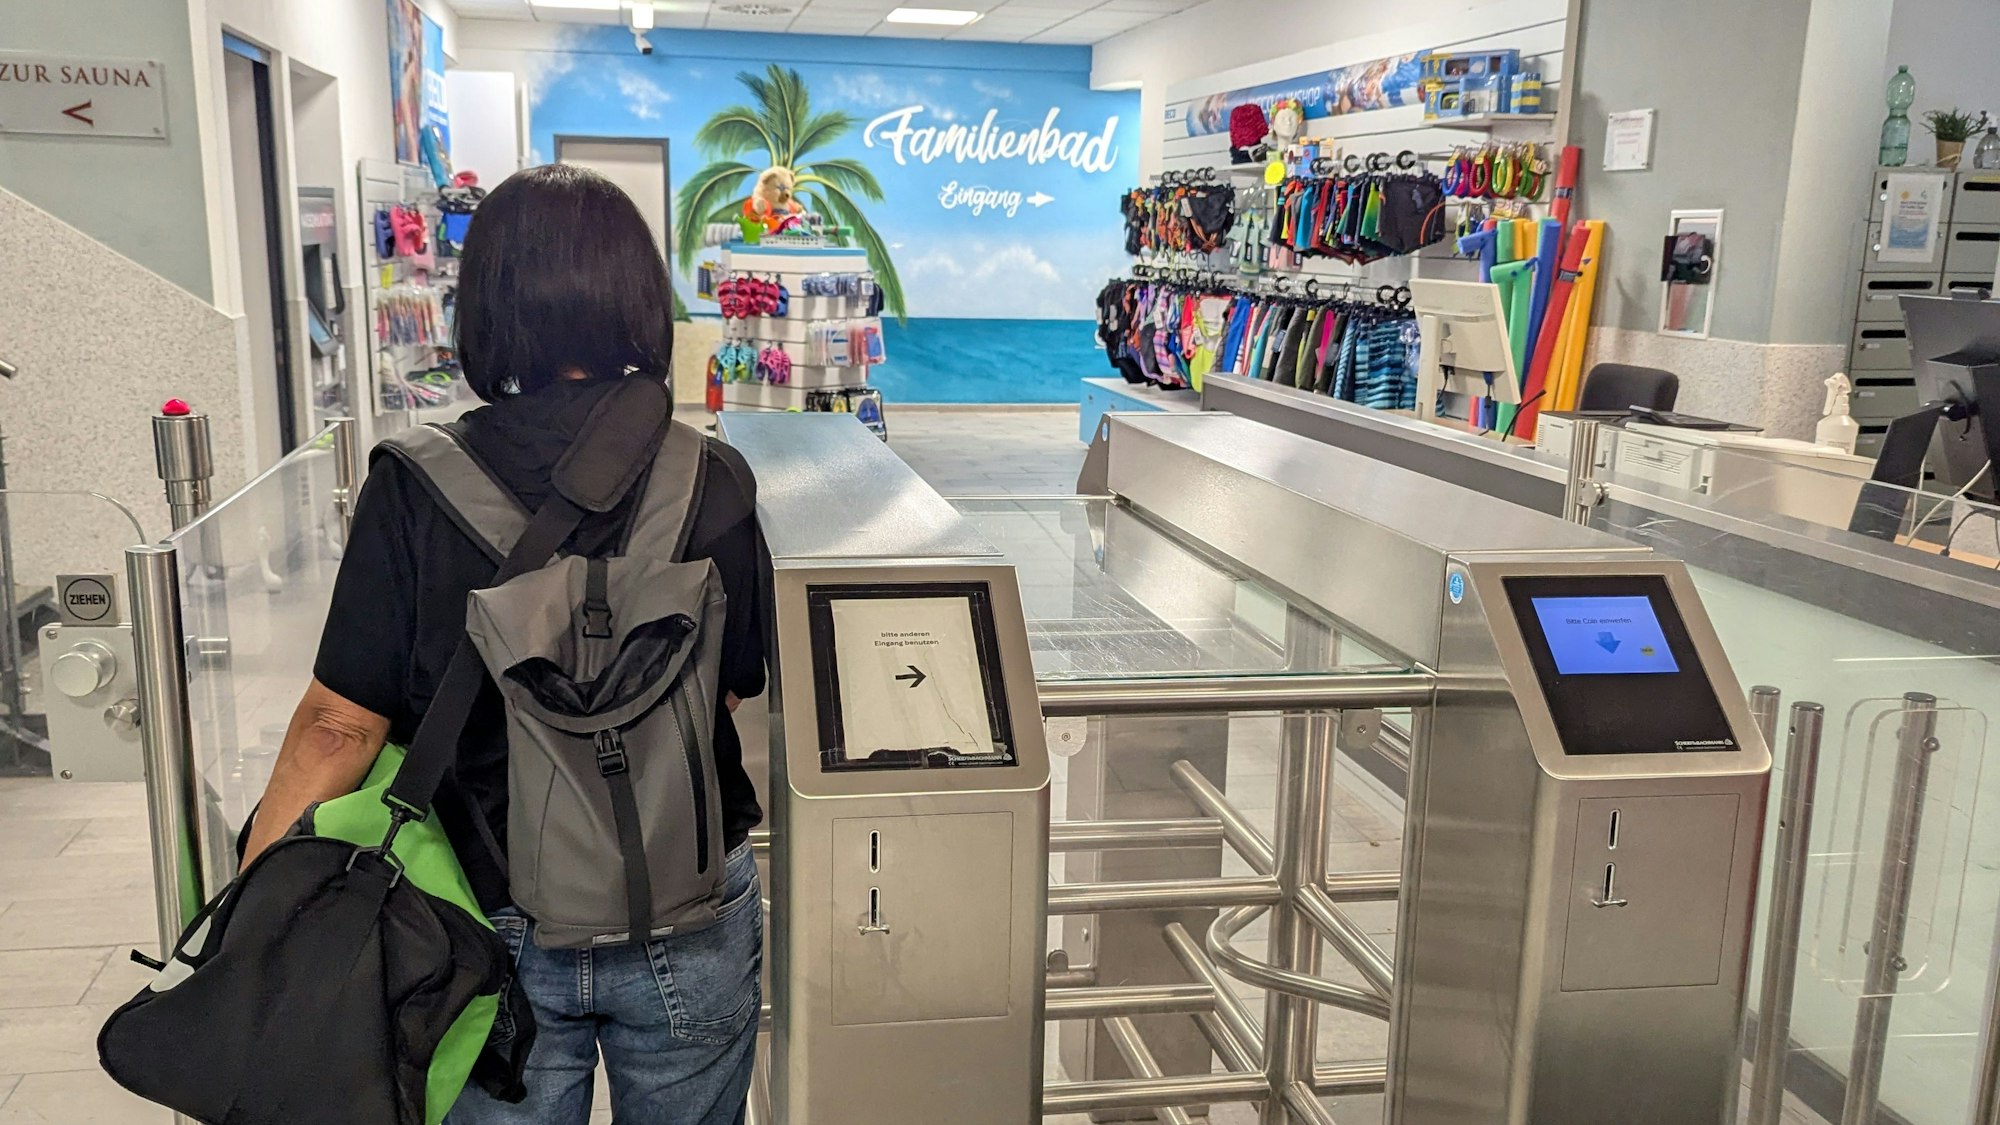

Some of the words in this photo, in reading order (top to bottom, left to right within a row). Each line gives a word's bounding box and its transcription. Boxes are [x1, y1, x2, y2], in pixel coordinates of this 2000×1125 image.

[0, 63, 51, 83] ZUR
[60, 65, 151, 88] SAUNA
[863, 105, 1120, 174] Familienbad
[938, 180, 1023, 218] Eingang
[69, 594, 106, 605] ZIEHEN
